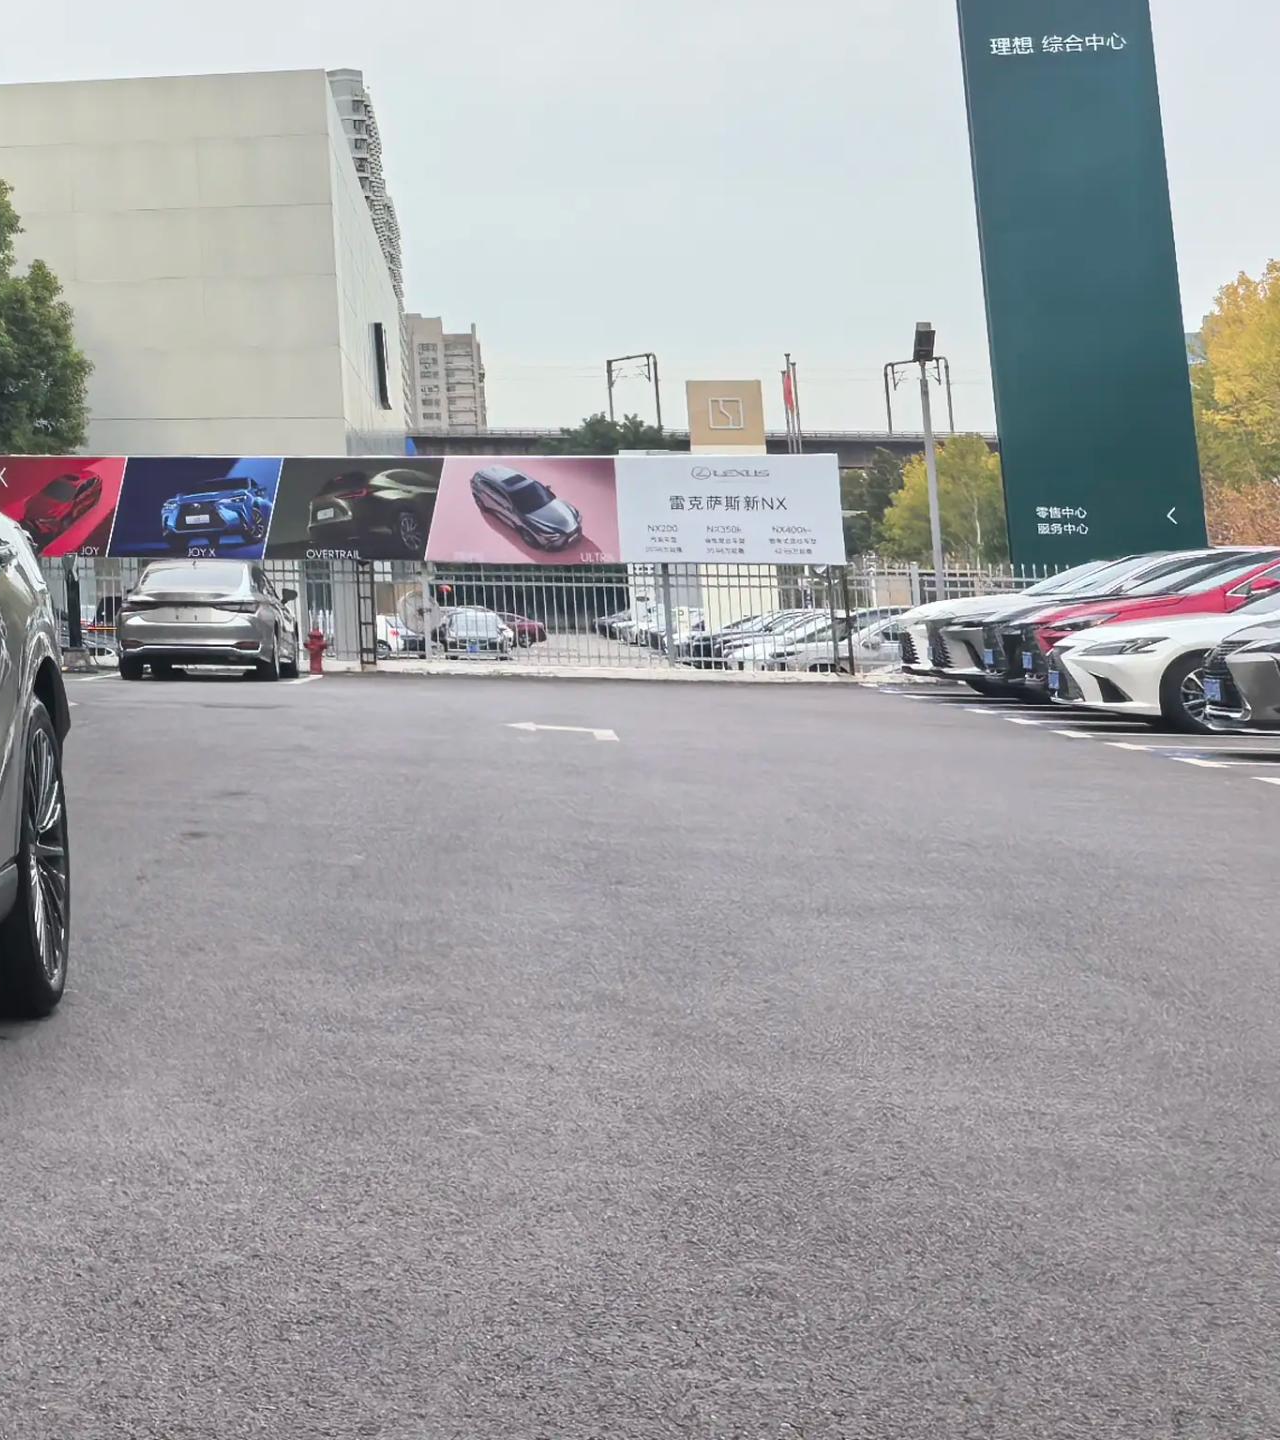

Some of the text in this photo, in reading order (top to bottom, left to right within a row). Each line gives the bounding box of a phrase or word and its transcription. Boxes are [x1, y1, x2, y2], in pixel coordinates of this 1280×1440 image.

[990, 32, 1128, 56] 理想 综合中心
[713, 469, 770, 477] LEXUS
[669, 495, 788, 511] 雷克萨斯新NX
[1035, 506, 1088, 519] 零售中心
[1037, 522, 1089, 535] 服务中心
[81, 546, 99, 556] JOY
[188, 548, 216, 558] JOY X
[306, 549, 361, 560] OVERTRAIL
